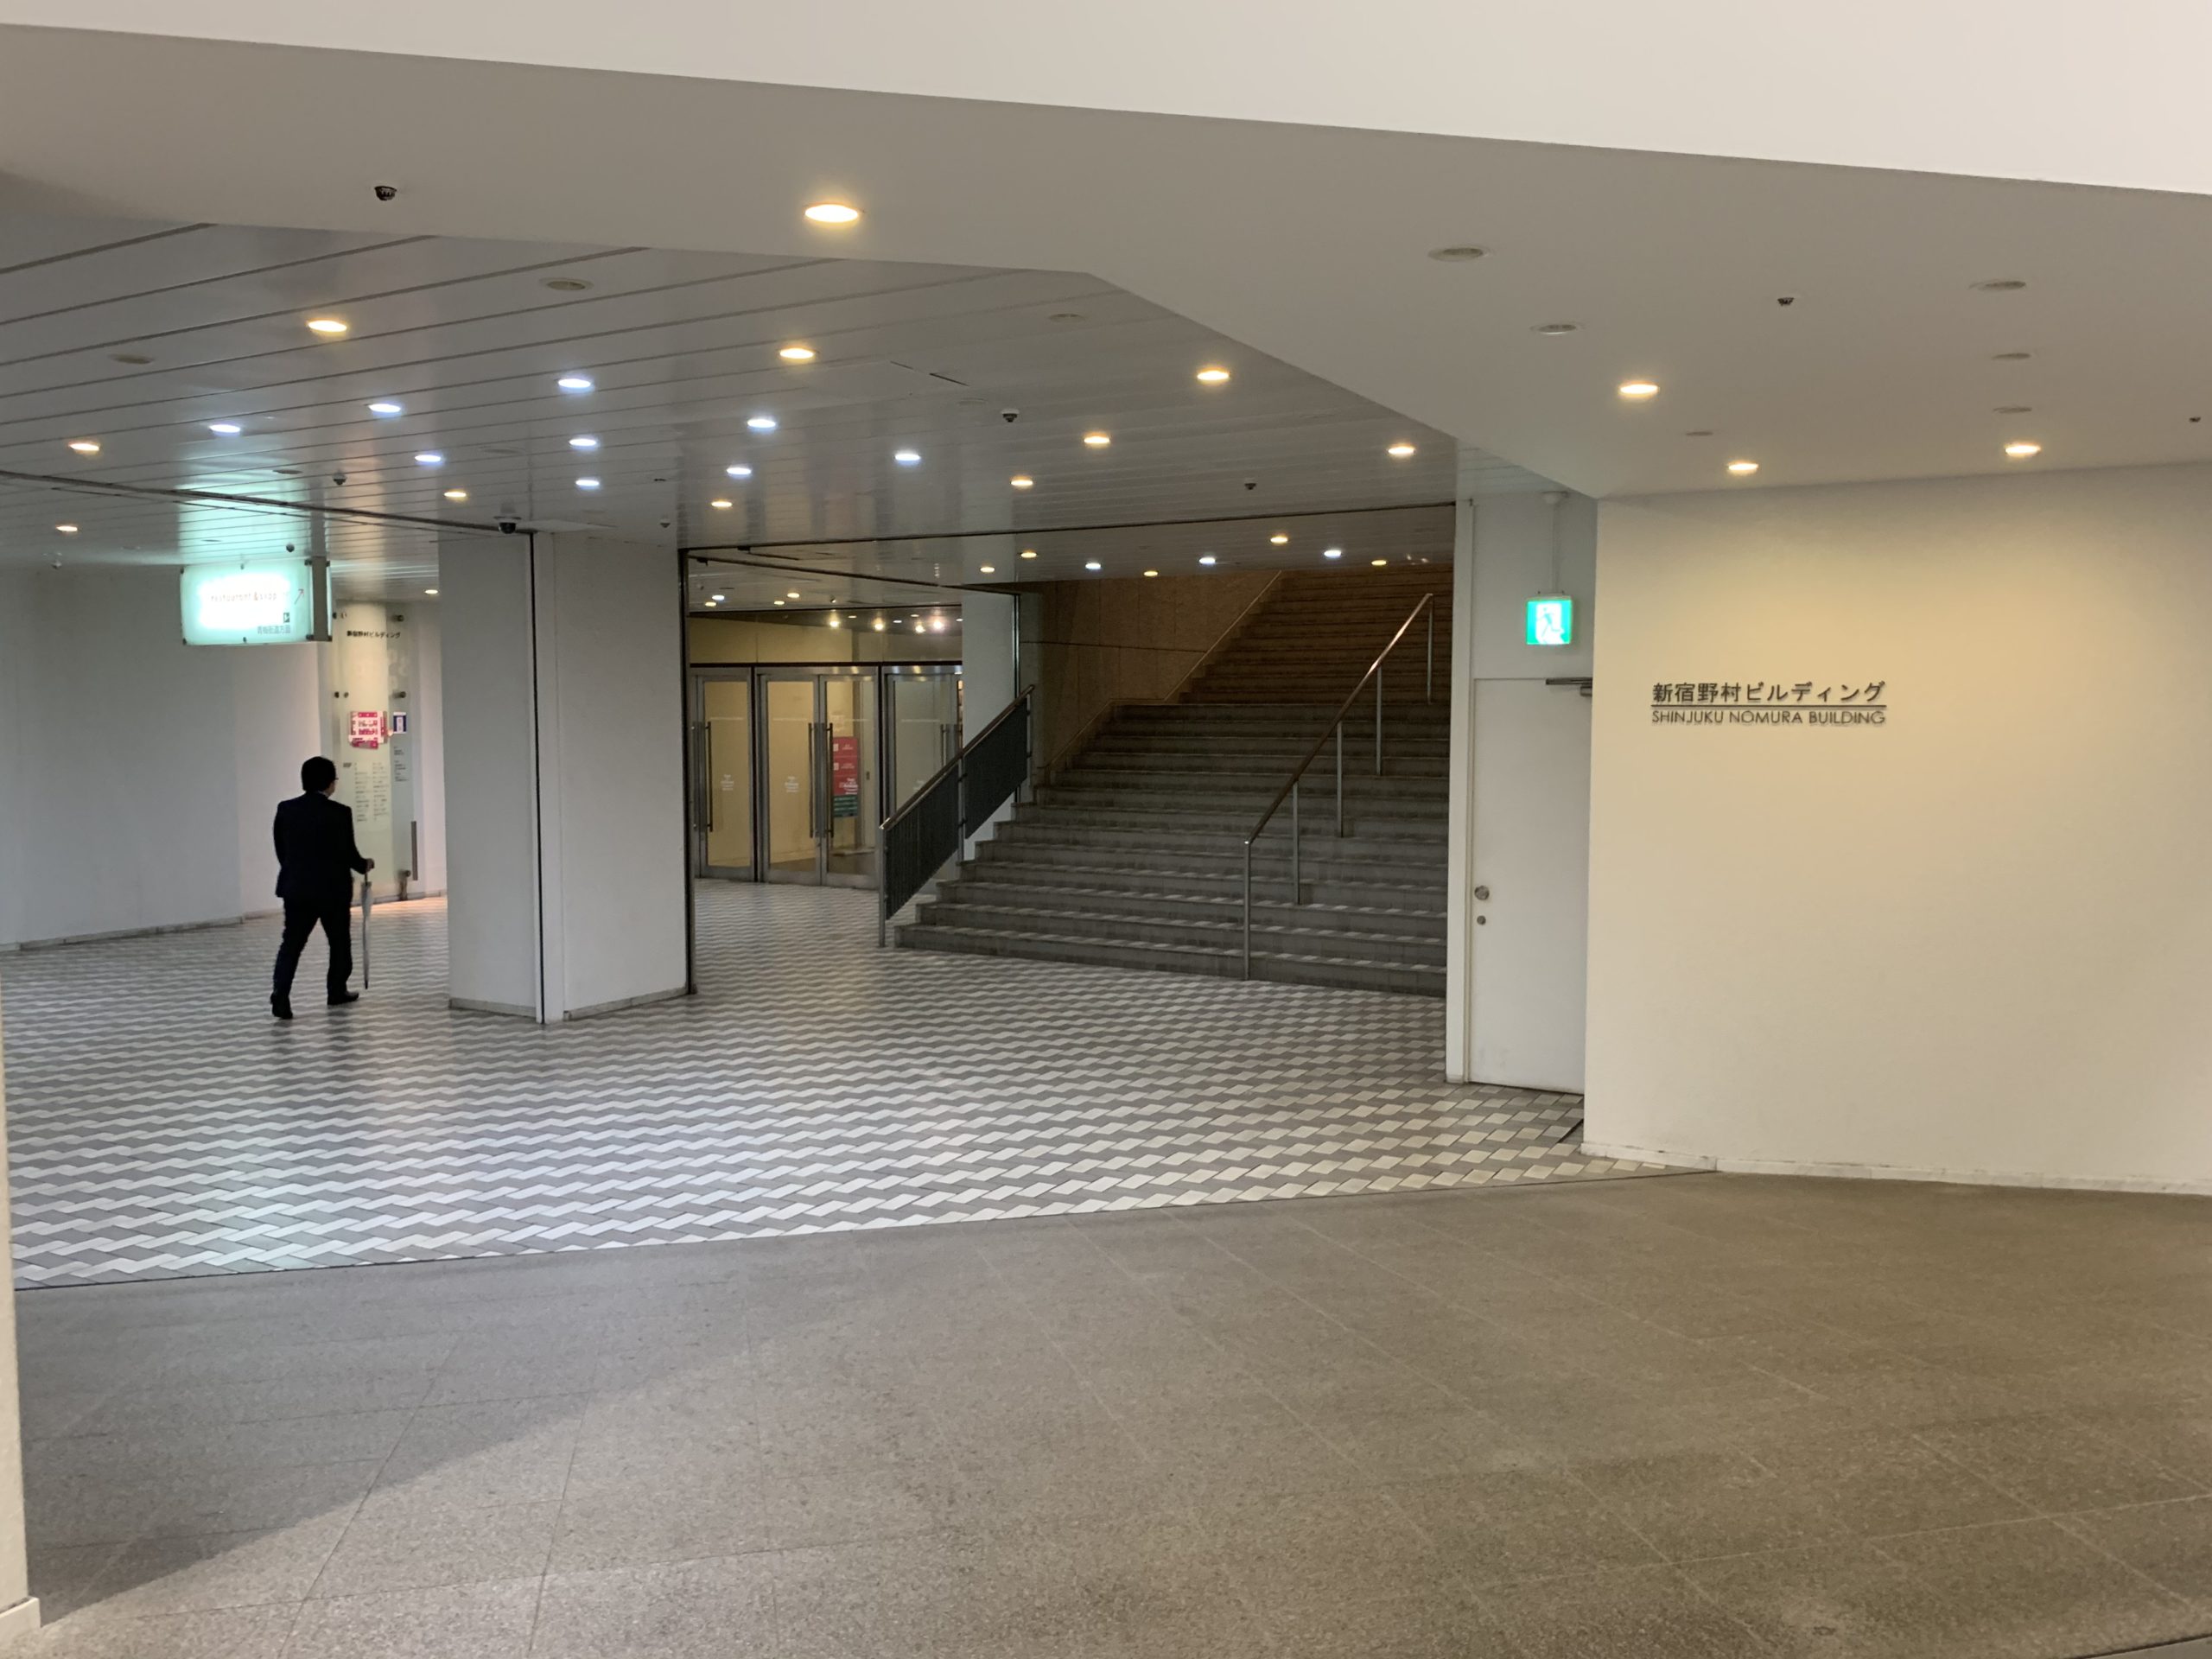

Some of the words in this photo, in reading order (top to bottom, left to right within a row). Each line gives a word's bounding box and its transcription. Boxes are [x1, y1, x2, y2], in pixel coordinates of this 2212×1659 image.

[1652, 681, 1885, 702] 新宿野村ビルディング
[1652, 710, 1724, 724] SHINJUKU
[1729, 710, 1803, 724] NOMURA
[1809, 710, 1885, 724] BUILDING
